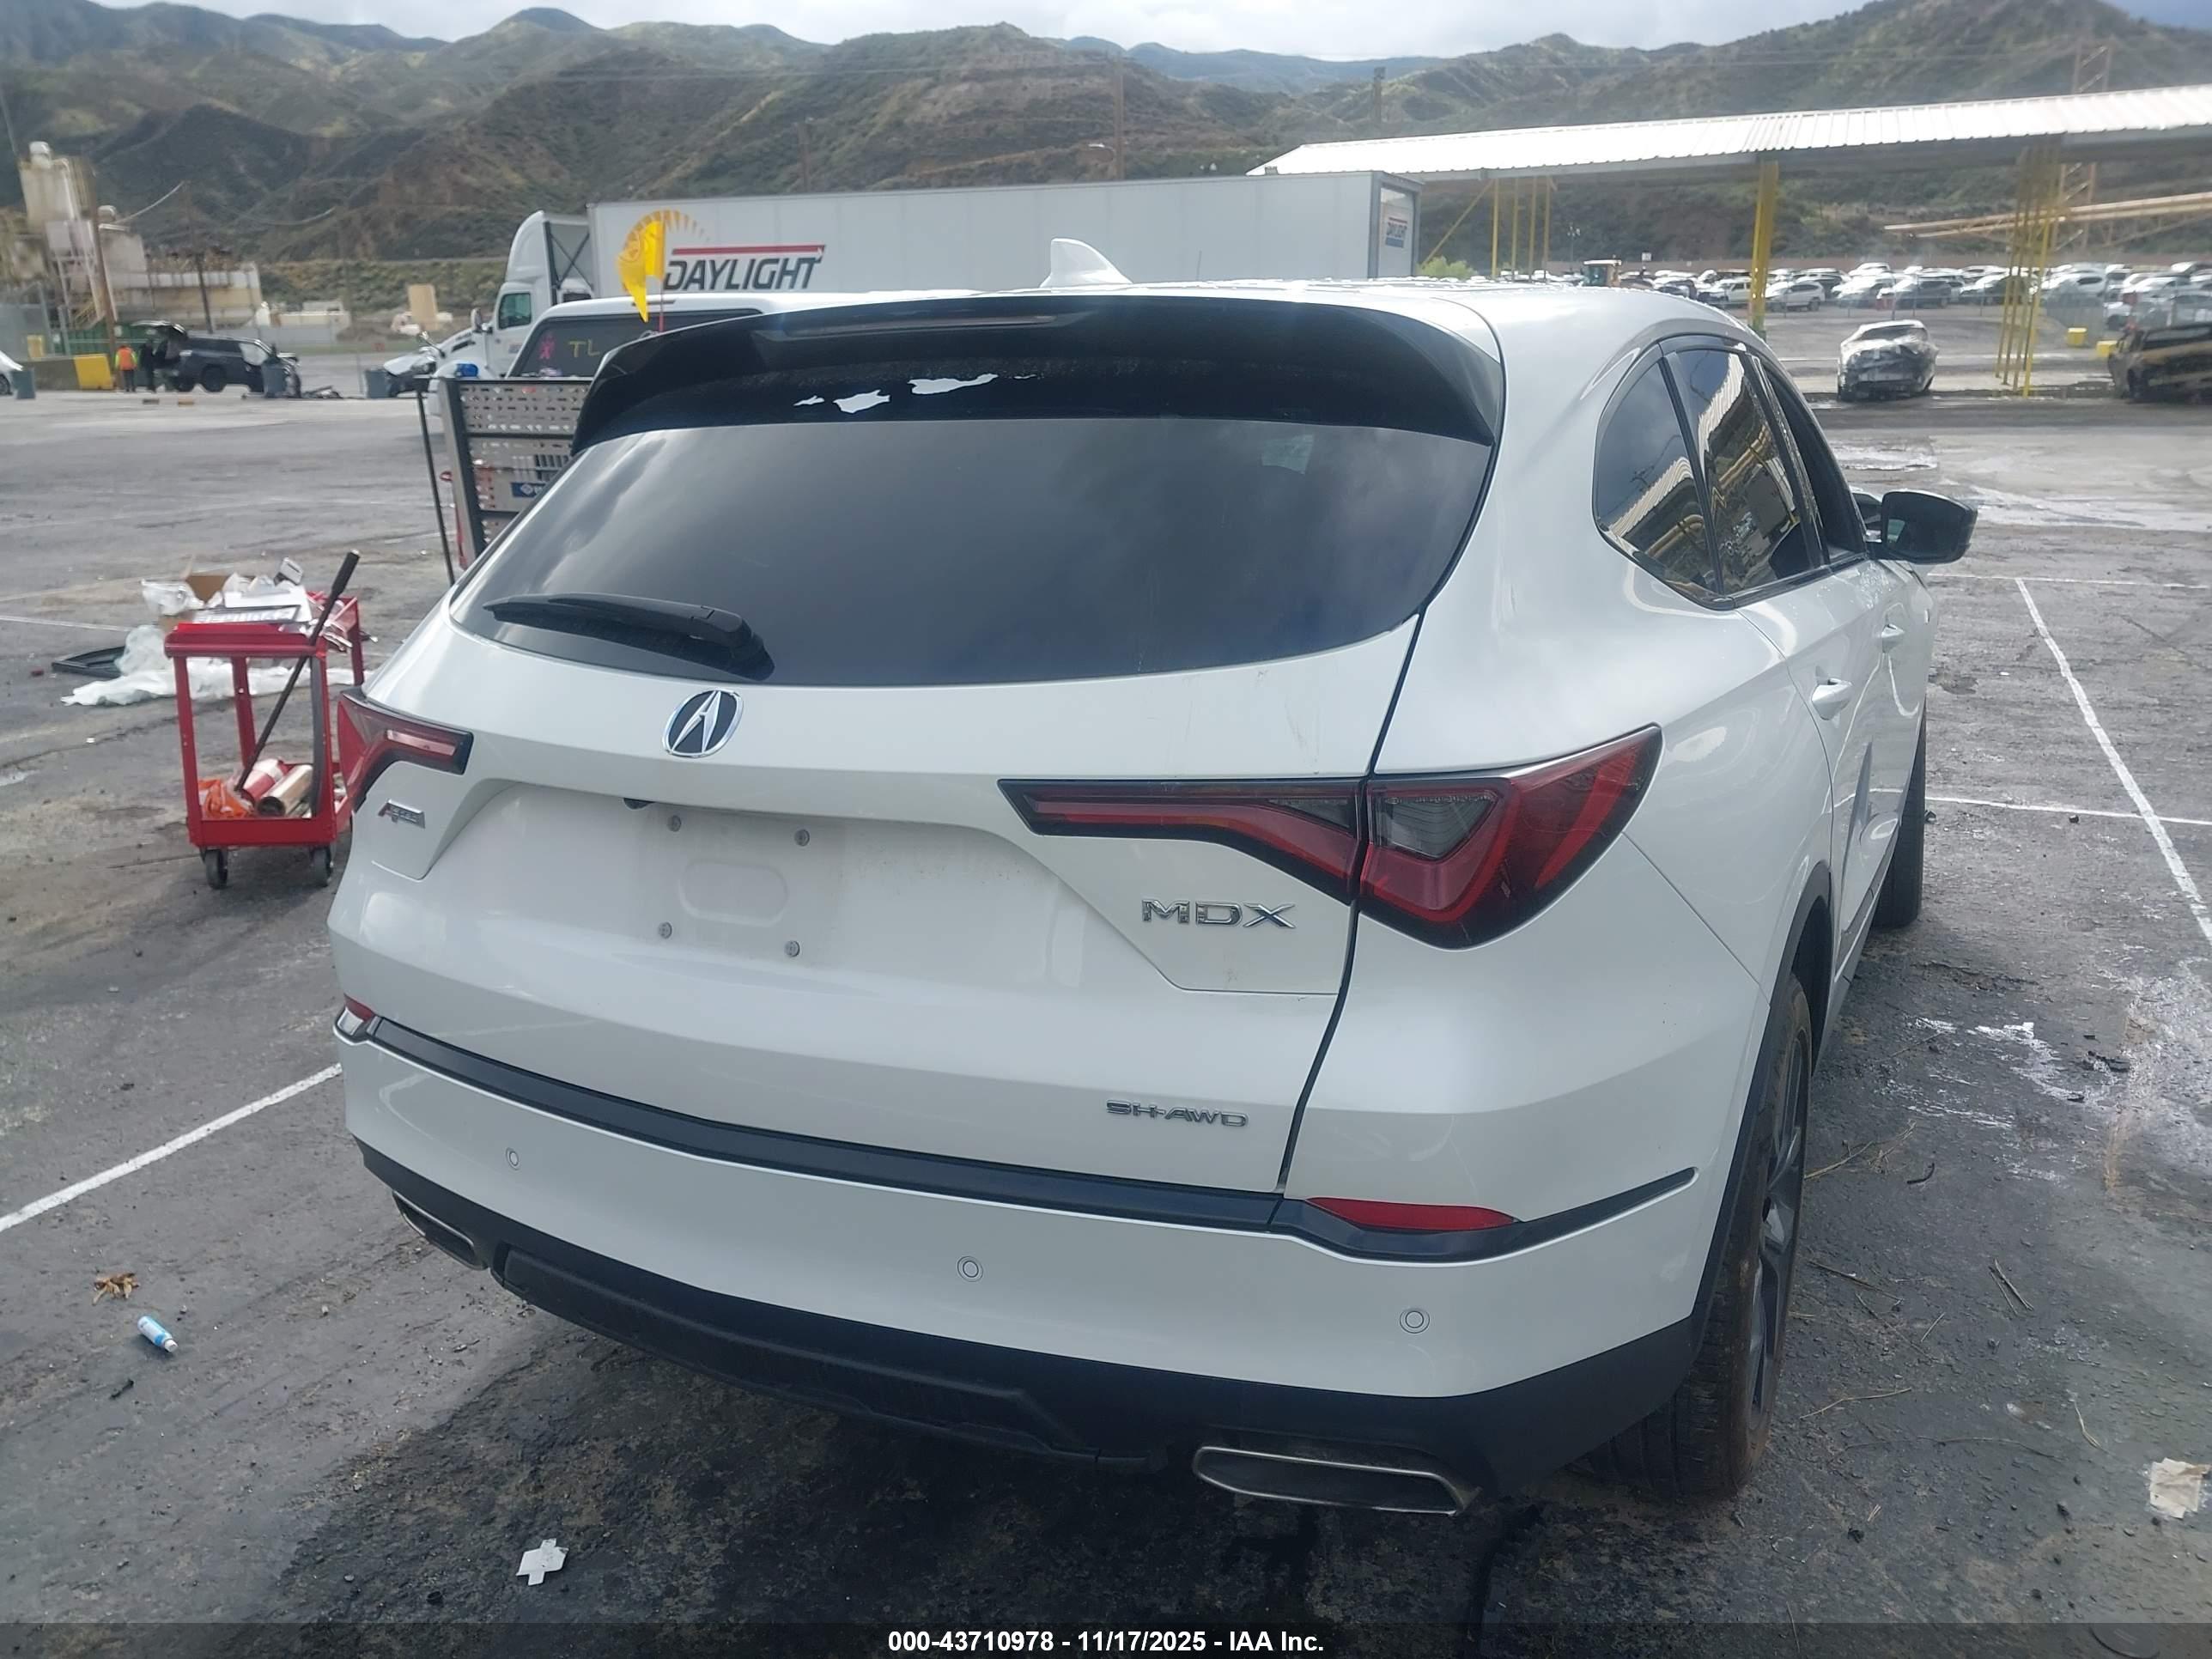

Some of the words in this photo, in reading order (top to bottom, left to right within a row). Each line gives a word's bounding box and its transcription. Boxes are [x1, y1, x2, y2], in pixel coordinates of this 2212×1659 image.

[663, 257, 822, 290] DAYLIGHT
[1141, 899, 1296, 928] MDX
[1106, 1099, 1249, 1127] SH-AWD
